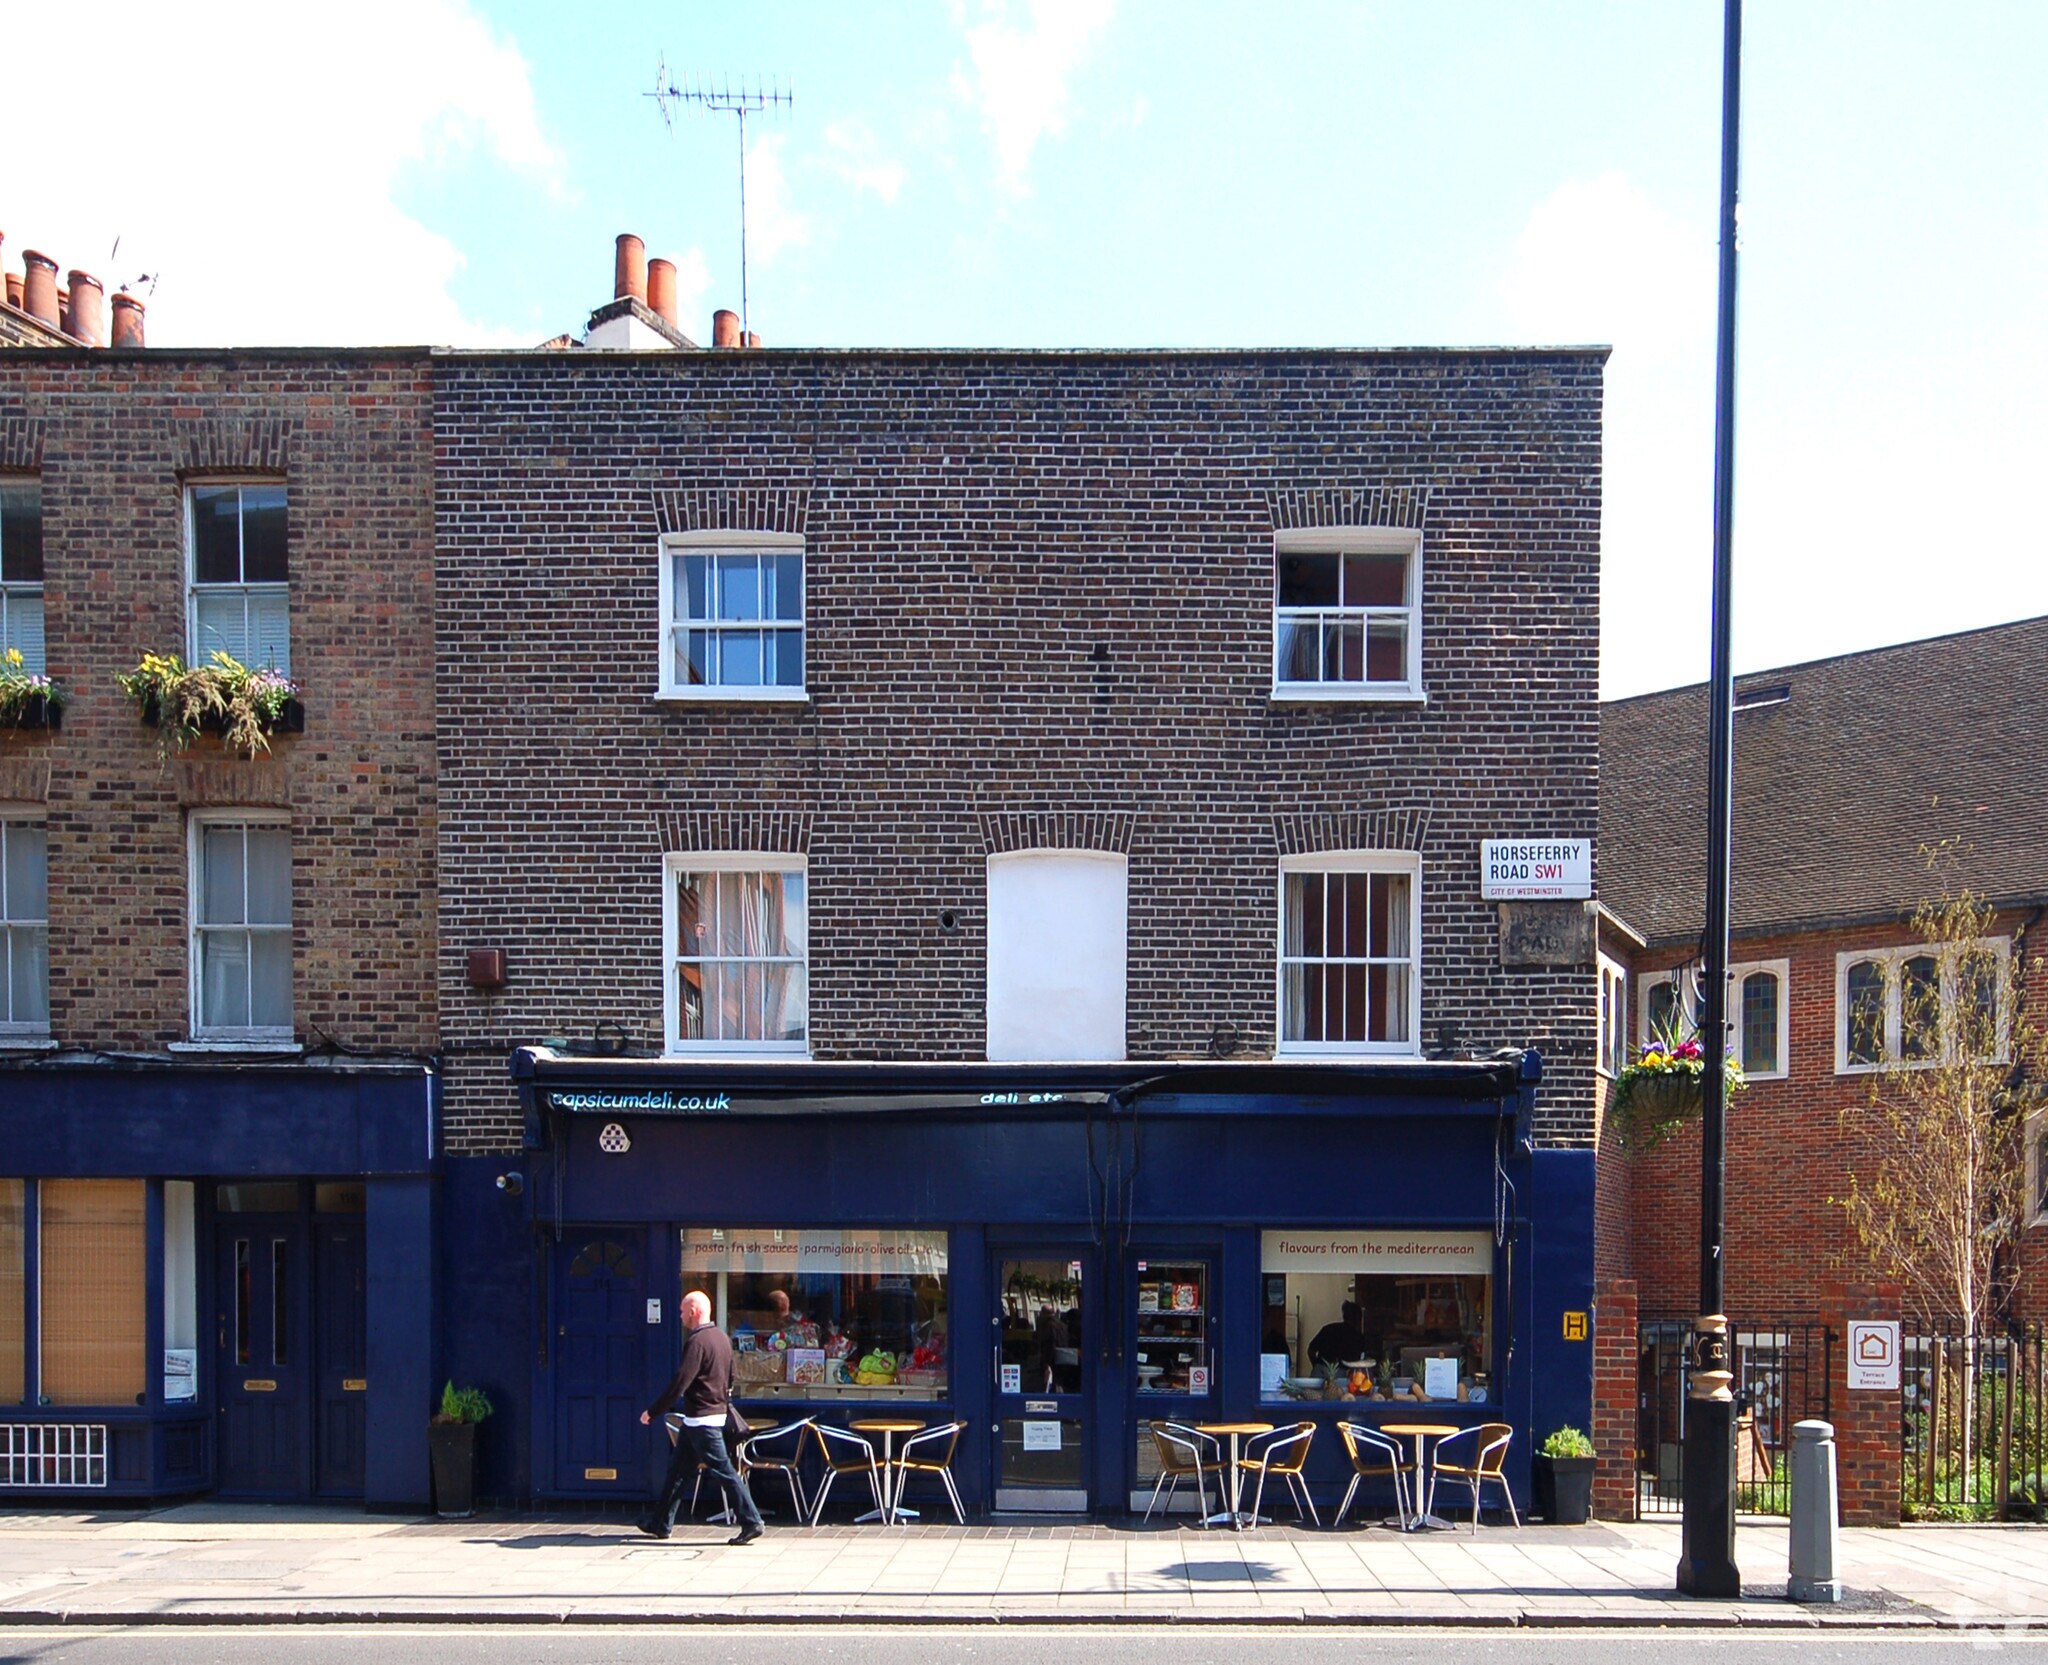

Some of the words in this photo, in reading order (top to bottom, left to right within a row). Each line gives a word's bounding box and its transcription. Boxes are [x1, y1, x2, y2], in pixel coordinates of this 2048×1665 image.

[1490, 845, 1580, 861] HORSEFERRY
[1490, 864, 1529, 879] ROAD
[1534, 864, 1563, 879] SW1
[1490, 888, 1505, 896] CITY
[1517, 887, 1563, 895] WESTMINSTER
[552, 1090, 731, 1111] capsicumdeli.co.uk
[980, 1092, 1019, 1104] deli
[695, 1243, 724, 1255] pasta
[763, 1245, 798, 1253] sauces
[804, 1242, 864, 1256] parmigiano
[870, 1243, 895, 1254] olive
[897, 1242, 910, 1254] oil
[1279, 1242, 1327, 1254] flavours
[1330, 1241, 1358, 1254] from
[1362, 1242, 1383, 1254] the
[1387, 1242, 1474, 1254] mediterranean
[1712, 1245, 1720, 1258] 7
[1567, 1314, 1584, 1337] H
